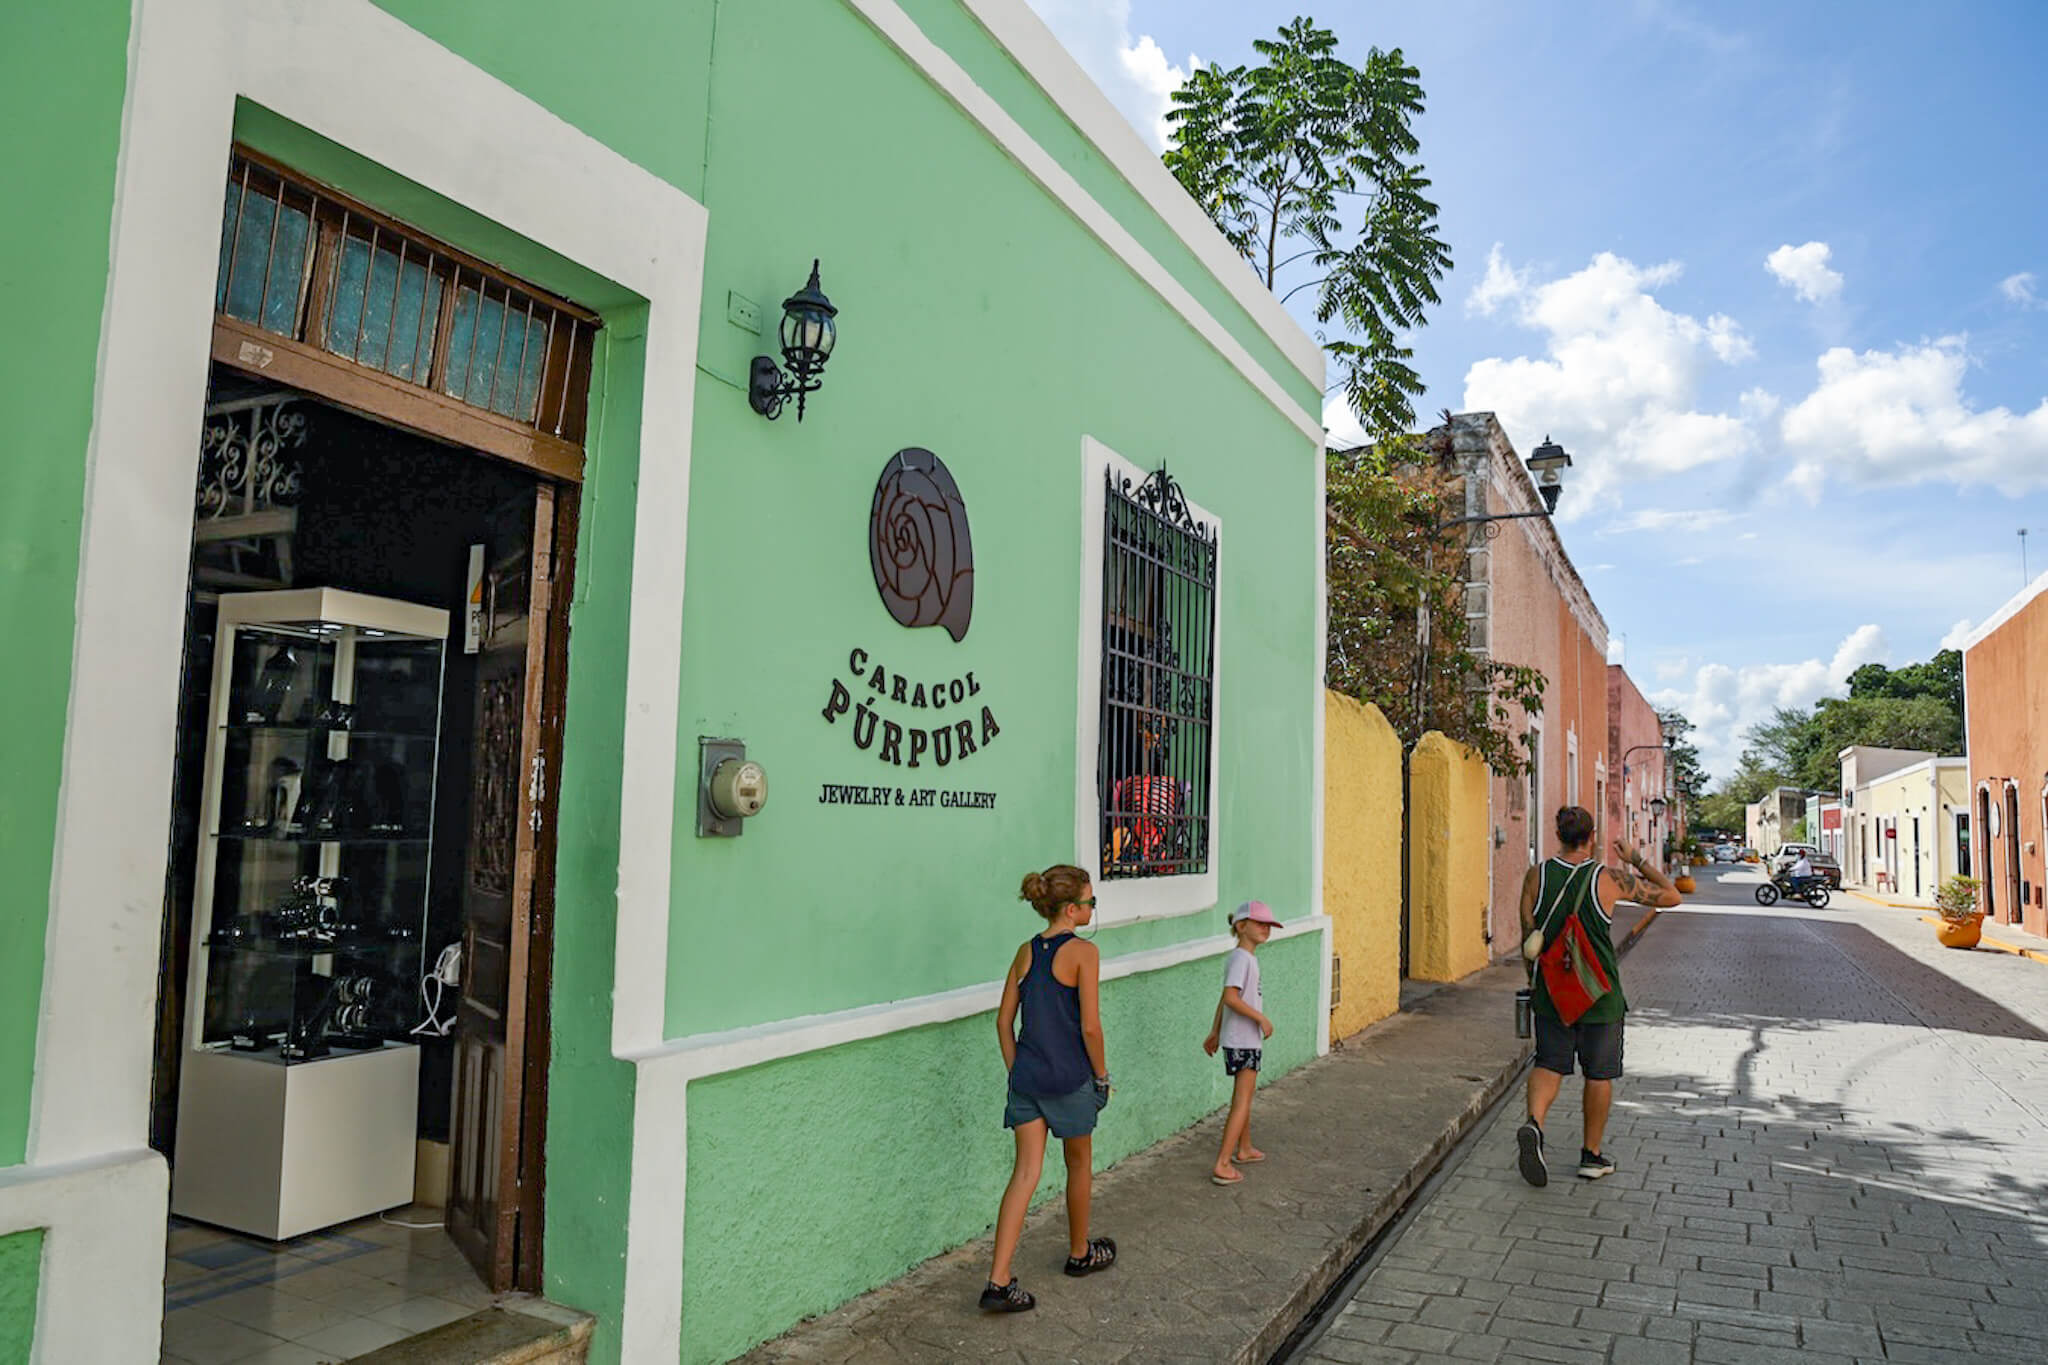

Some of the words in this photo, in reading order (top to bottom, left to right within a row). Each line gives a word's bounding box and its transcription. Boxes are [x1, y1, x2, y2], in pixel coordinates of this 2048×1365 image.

[849, 648, 981, 709] CARACOL
[821, 677, 1001, 768] PÚRPURA
[819, 784, 892, 806] JEWELRY
[894, 787, 905, 807] &
[908, 788, 937, 807] ART
[940, 790, 997, 810] GALLERY
